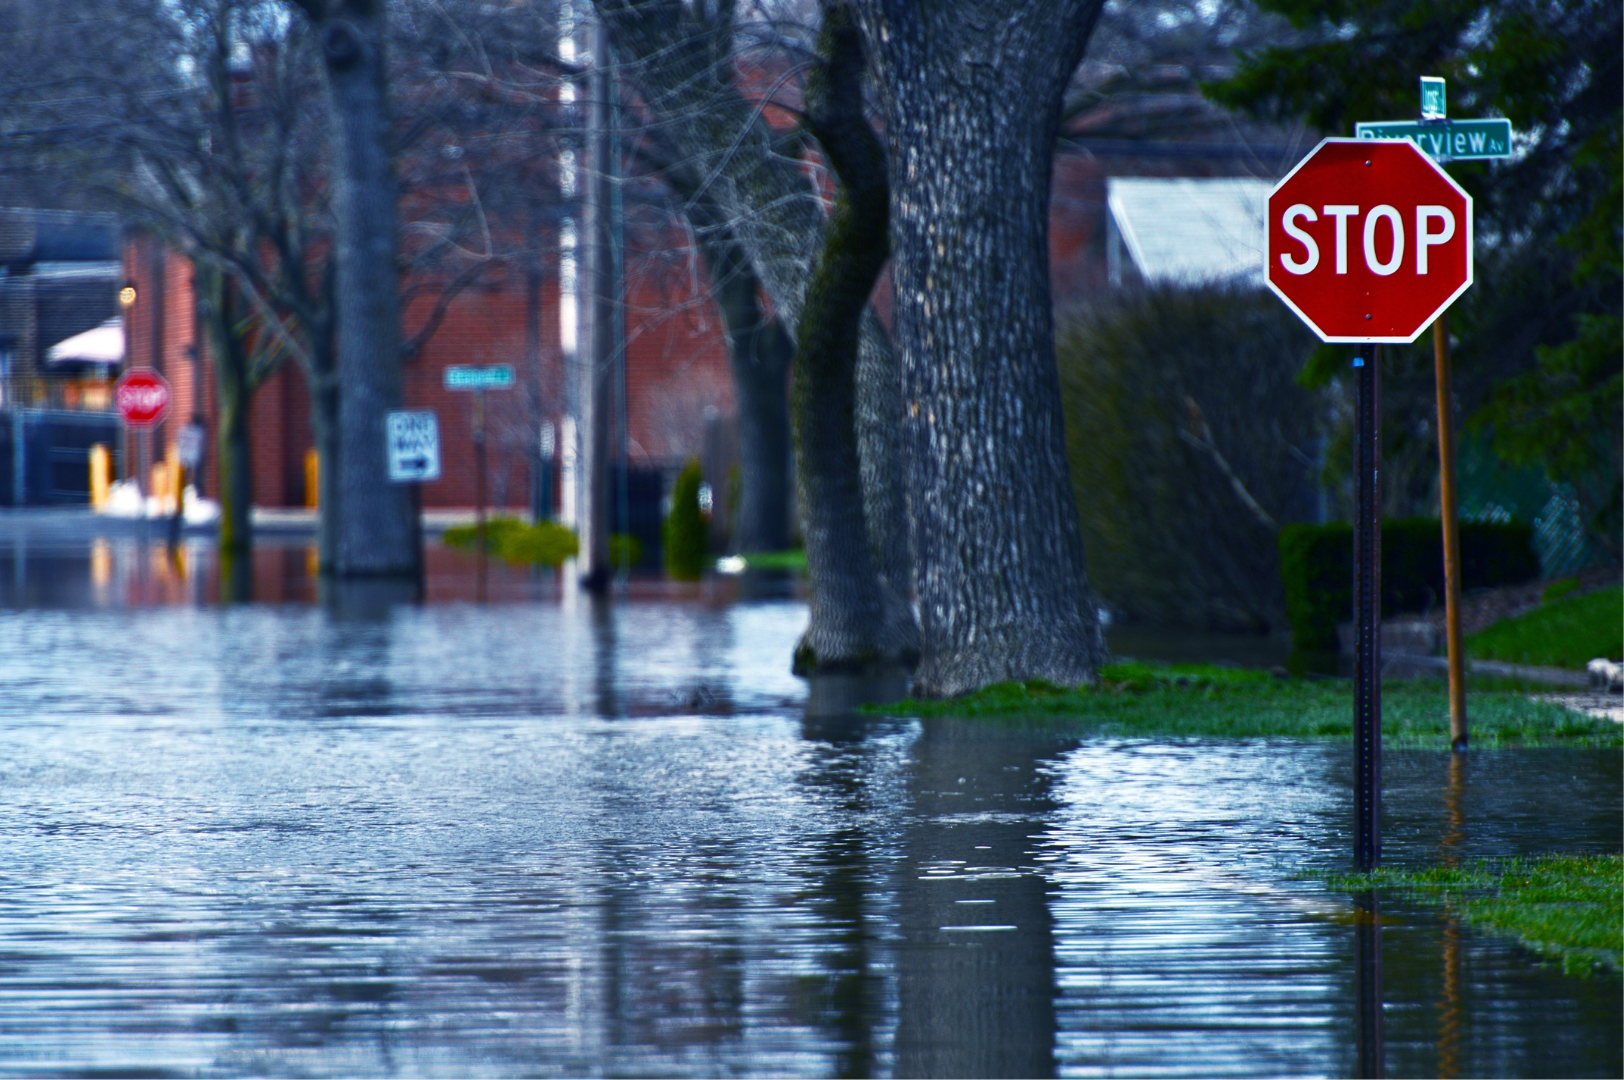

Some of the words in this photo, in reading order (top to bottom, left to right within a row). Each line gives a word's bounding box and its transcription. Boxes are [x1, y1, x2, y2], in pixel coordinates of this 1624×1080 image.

[1361, 126, 1487, 154] rview
[1280, 203, 1456, 276] STOP
[119, 385, 166, 410] STOP
[394, 413, 433, 431] ONE
[395, 433, 435, 451] WAY
